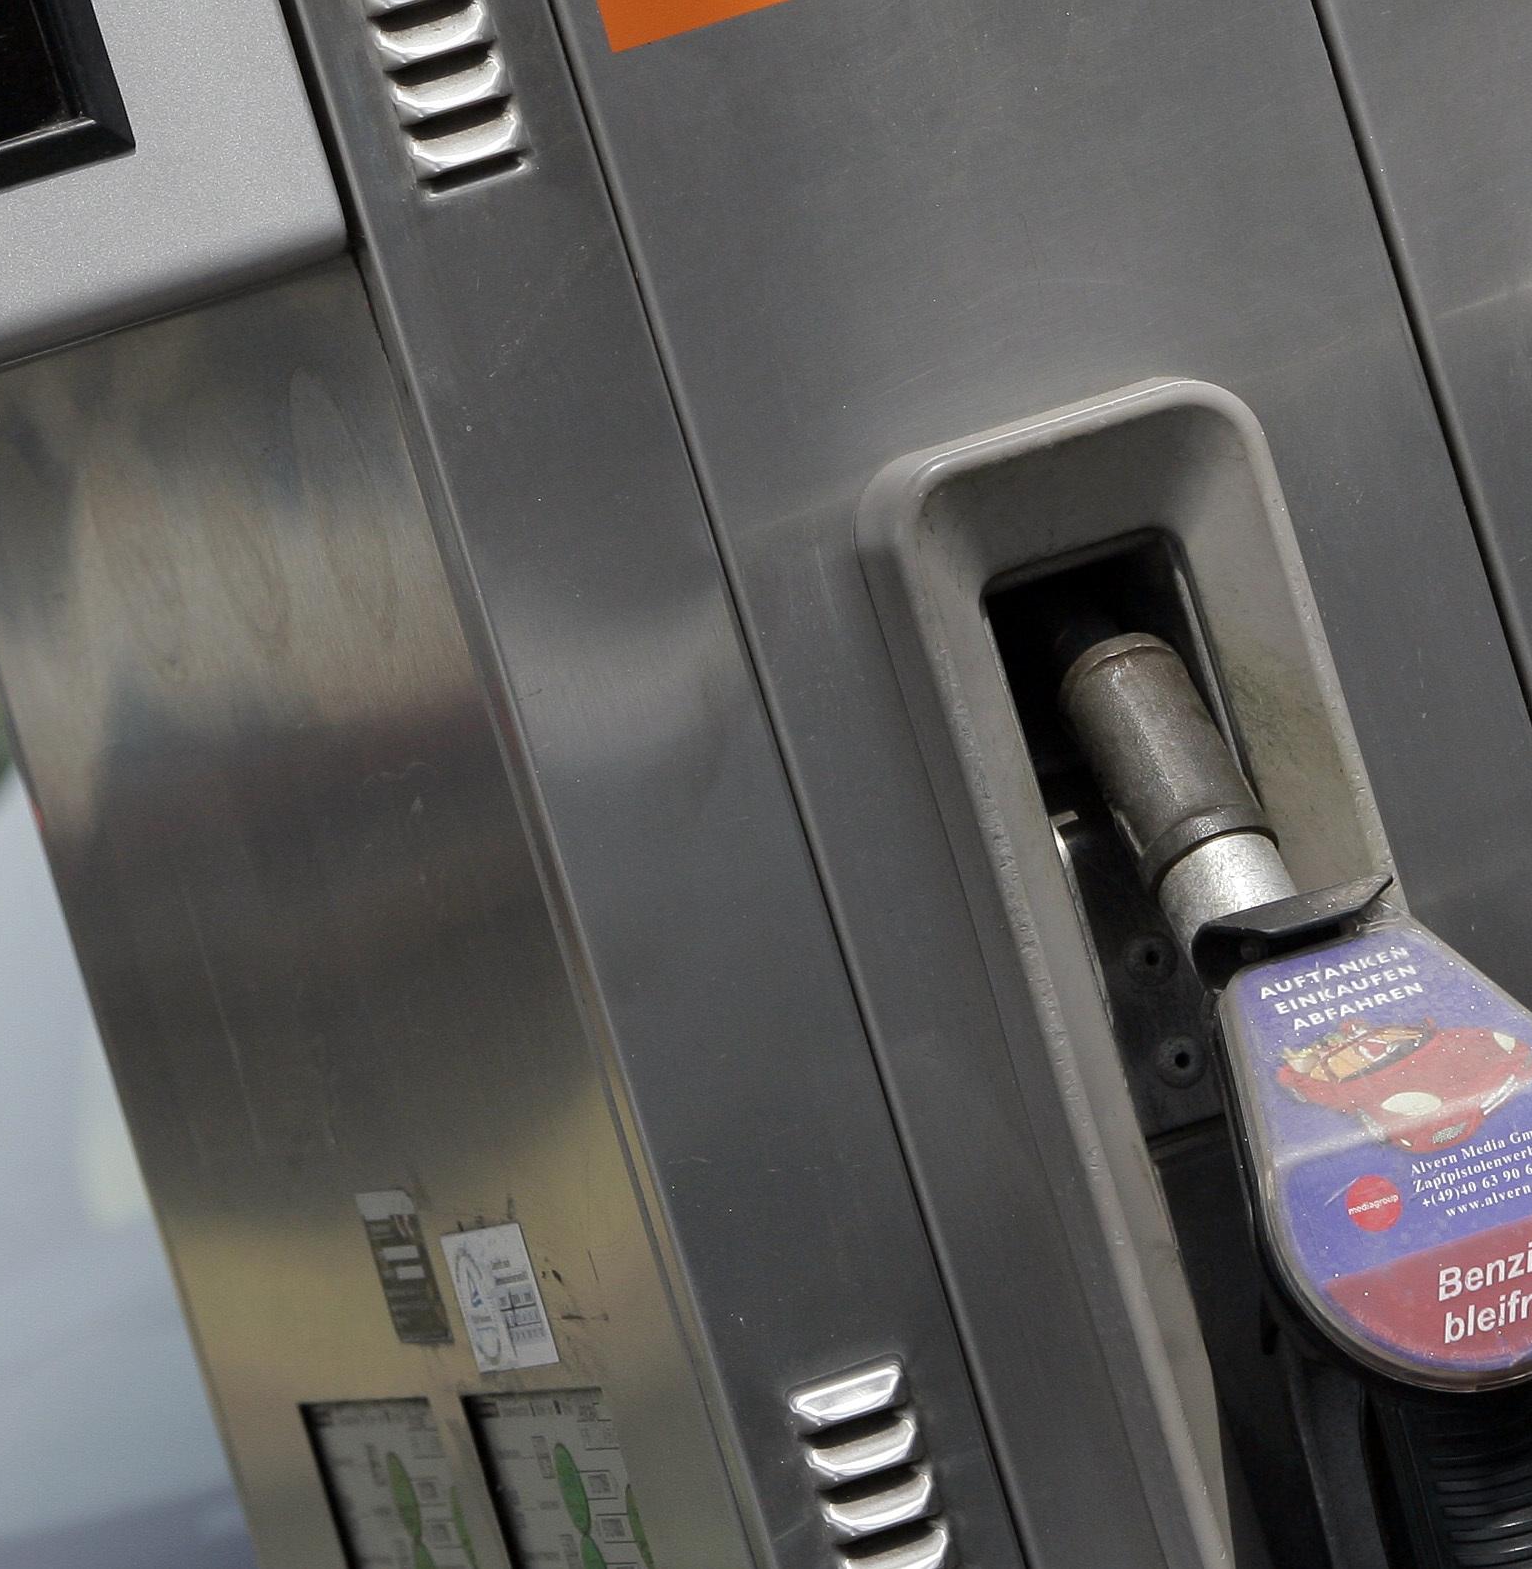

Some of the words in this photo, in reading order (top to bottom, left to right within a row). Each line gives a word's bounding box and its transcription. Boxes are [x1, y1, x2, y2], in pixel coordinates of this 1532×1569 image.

[1259, 945, 1410, 1000] AUFTANKEN
[1274, 964, 1418, 1015] EINKAUFEN
[1292, 982, 1425, 1031] ABFAHREN
[1411, 1154, 1458, 1177] Alvern
[1461, 1138, 1506, 1160] Media
[1348, 1193, 1399, 1216] mediagroup
[1422, 1181, 1478, 1209] +(49)40
[1482, 1174, 1499, 1190] 63
[1502, 1168, 1521, 1184] 90
